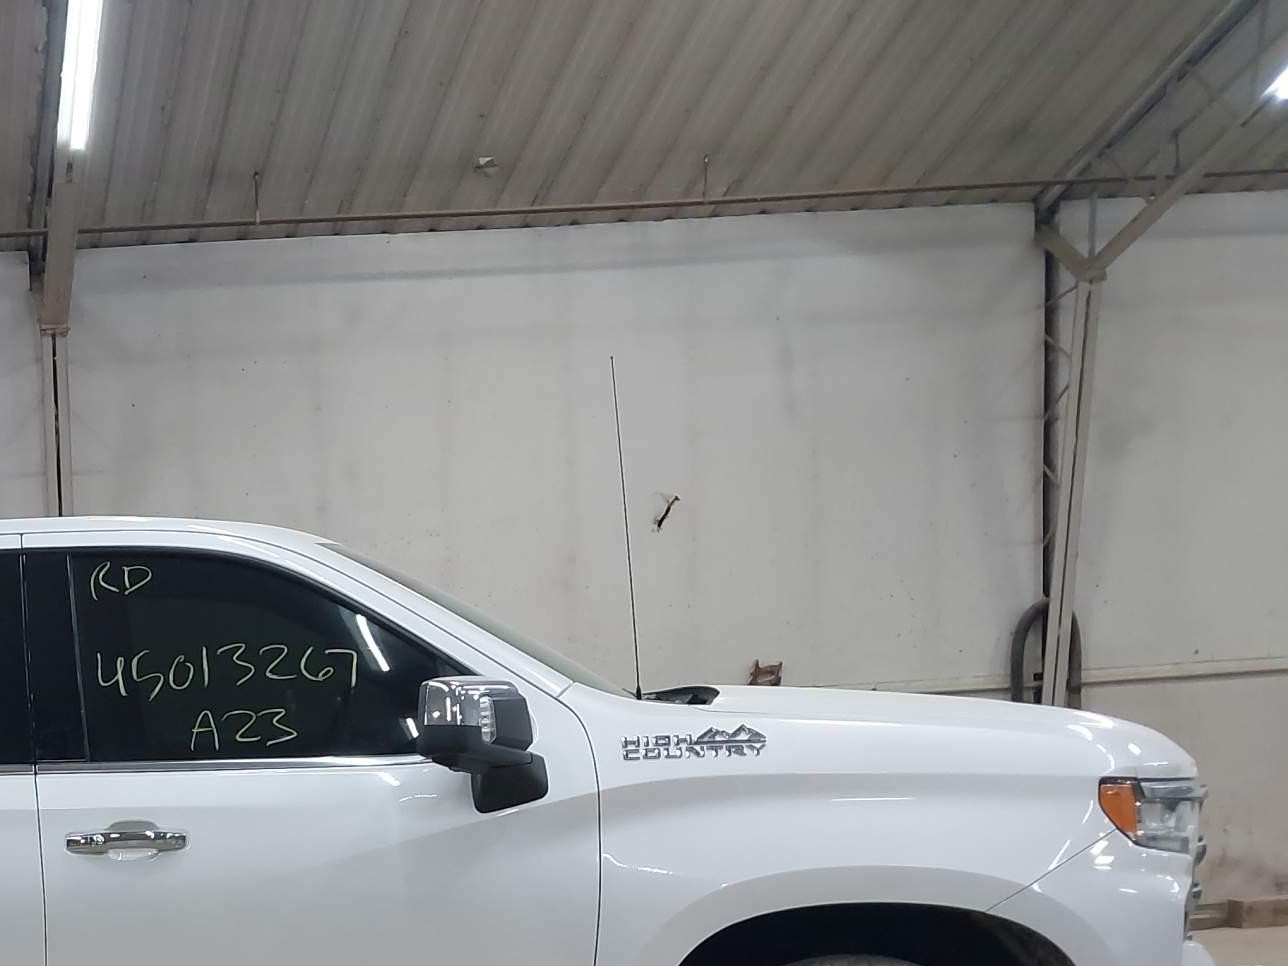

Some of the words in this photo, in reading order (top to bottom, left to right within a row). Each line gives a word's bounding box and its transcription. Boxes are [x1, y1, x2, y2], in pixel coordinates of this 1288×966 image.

[96, 643, 358, 702] 45013267
[190, 709, 299, 752] A23
[623, 744, 767, 760] COUNTRY
